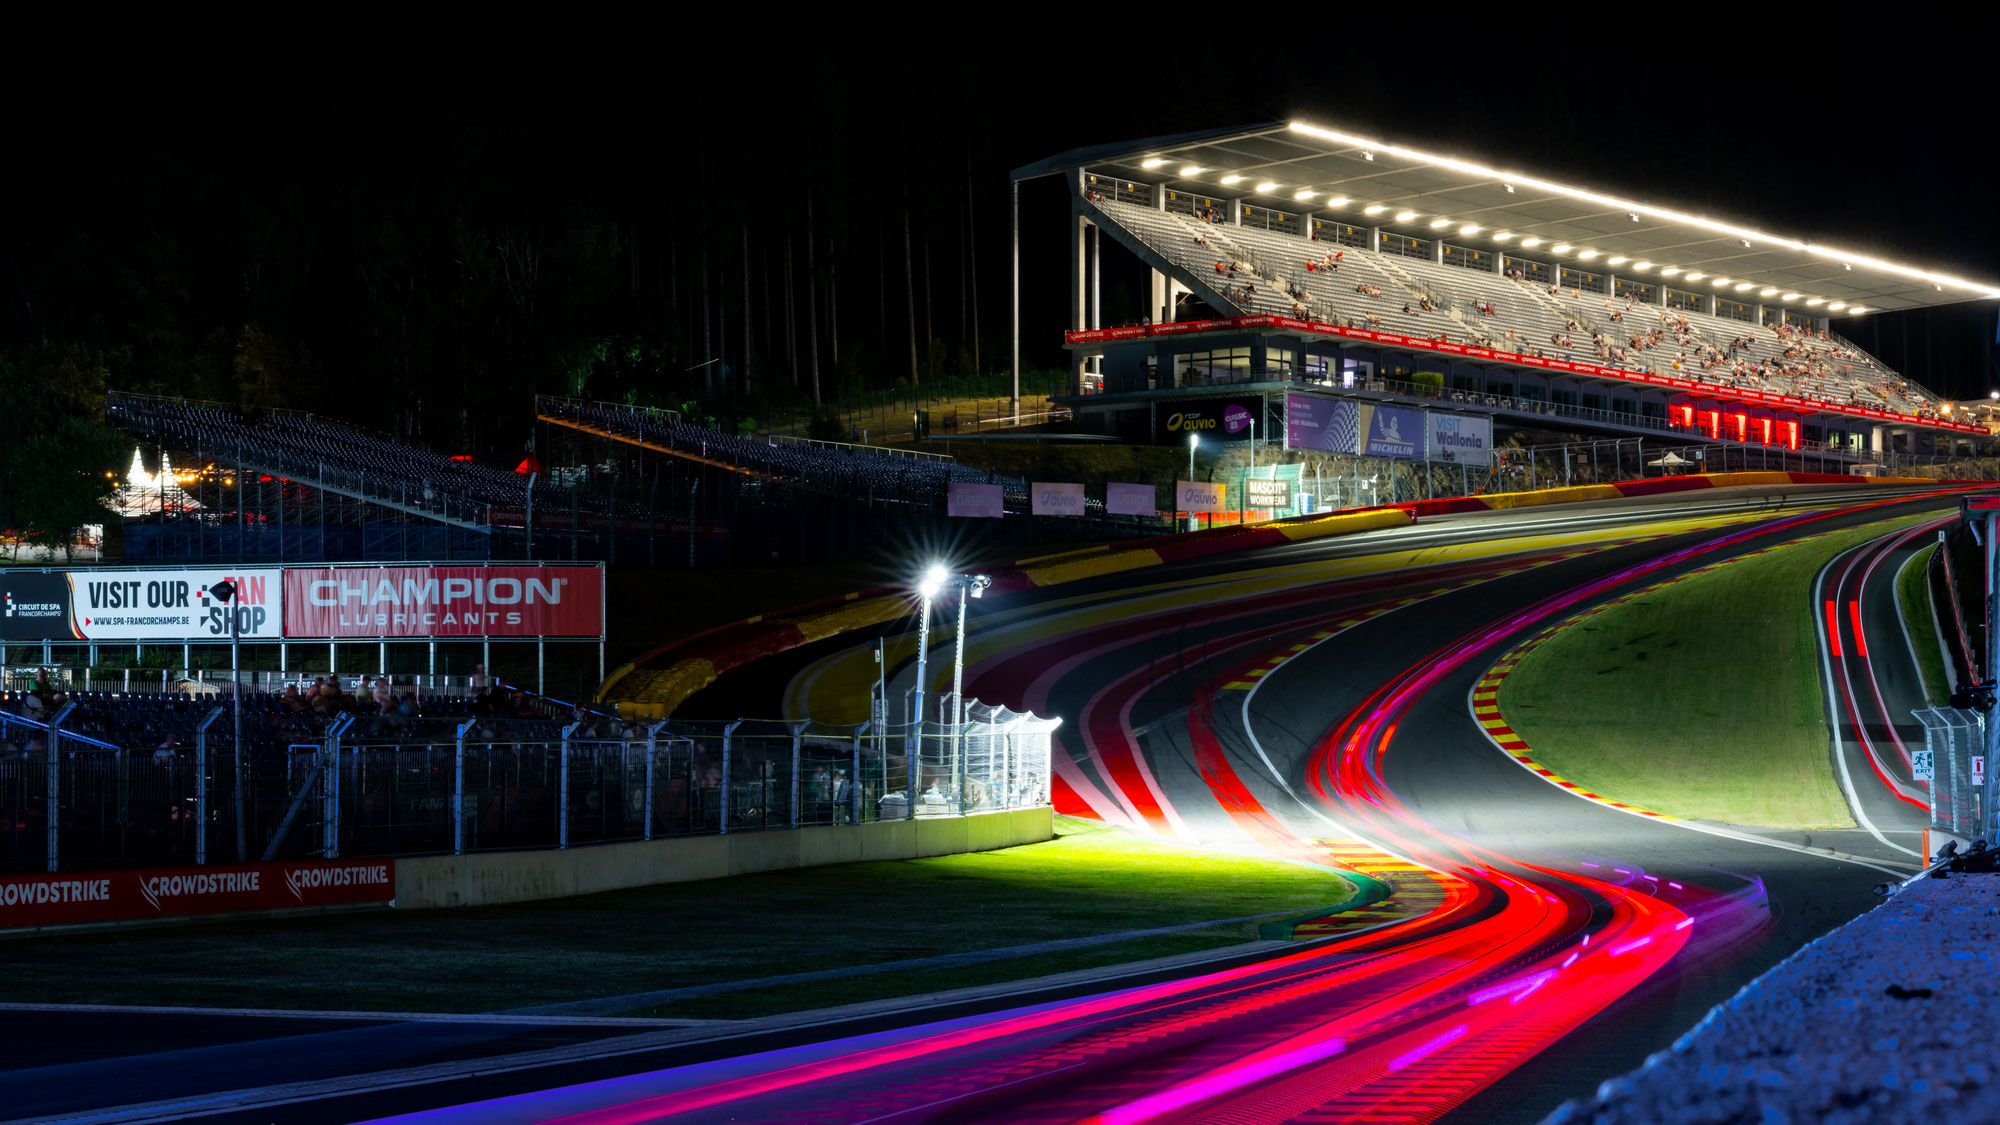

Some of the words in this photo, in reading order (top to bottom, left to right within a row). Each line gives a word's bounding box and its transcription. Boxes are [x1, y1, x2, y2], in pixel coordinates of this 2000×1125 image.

[1183, 418, 1216, 430] auvio
[1435, 416, 1462, 432] VISIT
[1436, 431, 1482, 448] Wallonia
[1369, 443, 1414, 455] MICHELIN
[1050, 495, 1076, 506] auvio
[1193, 494, 1217, 506] auvio
[1250, 494, 1287, 506] WORKWEAR
[88, 581, 141, 608] VISIT
[147, 580, 189, 608] OUR
[18, 603, 40, 611] CIRCUIT
[41, 603, 49, 611] DE
[49, 603, 61, 611] SPA
[93, 616, 190, 626] WWW.SPA-FRANCORCHAMPS.BE
[340, 612, 522, 626] LUBRICANTS
[291, 865, 389, 888] CROWDSTRIKE
[148, 871, 260, 897] CROWDSTRIKE
